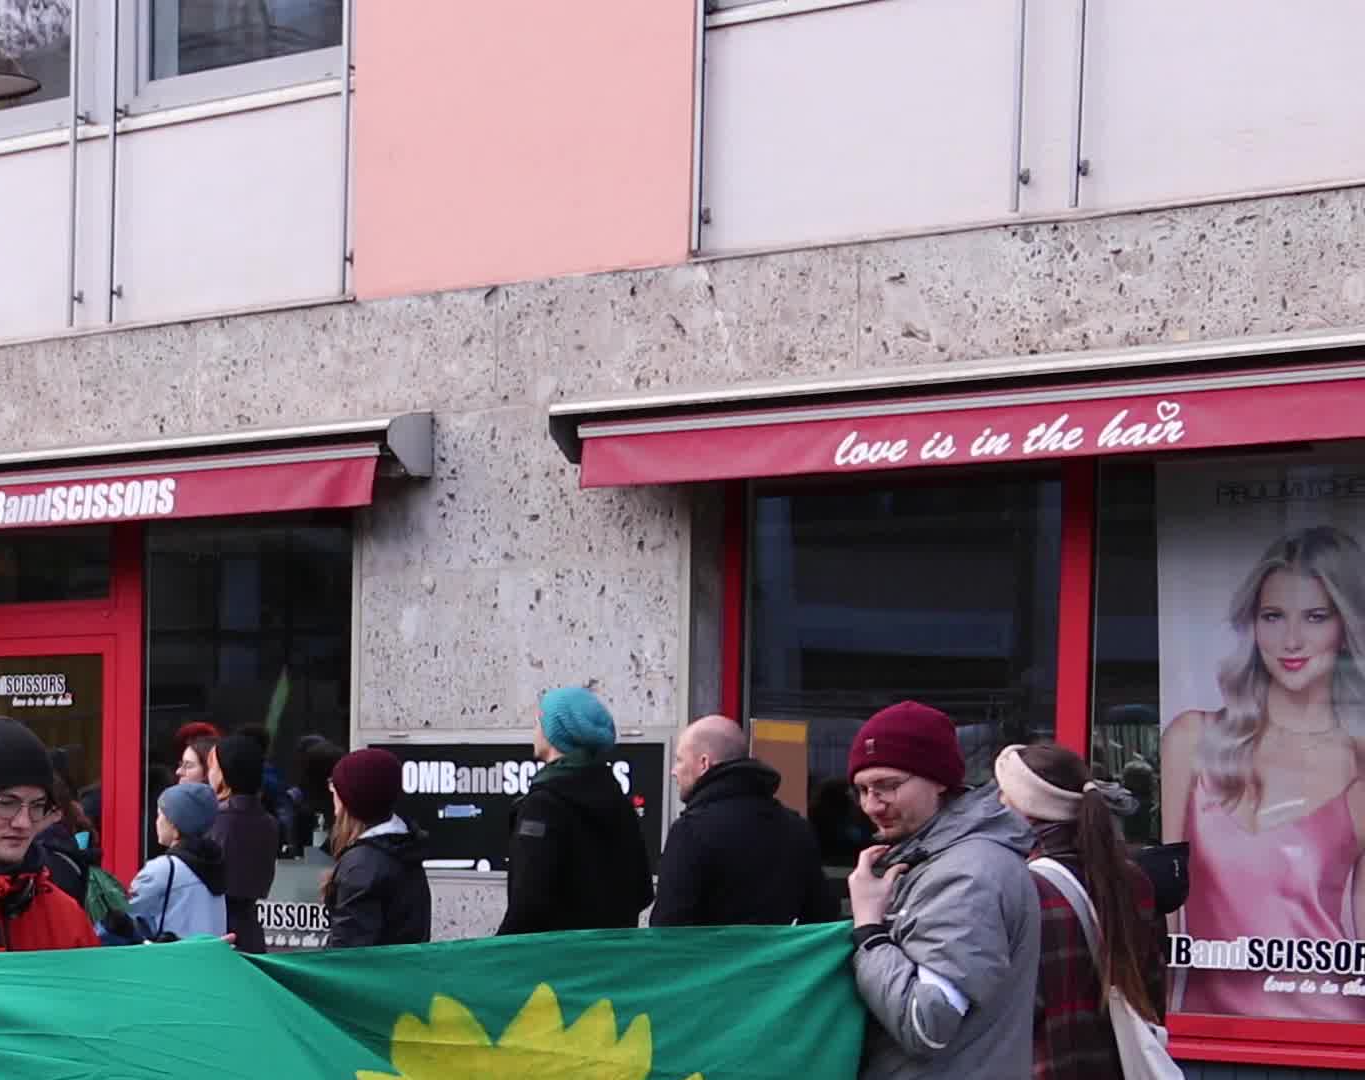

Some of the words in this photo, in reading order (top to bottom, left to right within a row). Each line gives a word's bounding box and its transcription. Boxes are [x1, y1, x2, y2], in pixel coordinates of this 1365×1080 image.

[834, 431, 909, 466] love
[921, 431, 956, 460] is
[970, 427, 1011, 457] in
[1022, 412, 1084, 455] the
[1097, 400, 1185, 450] hair
